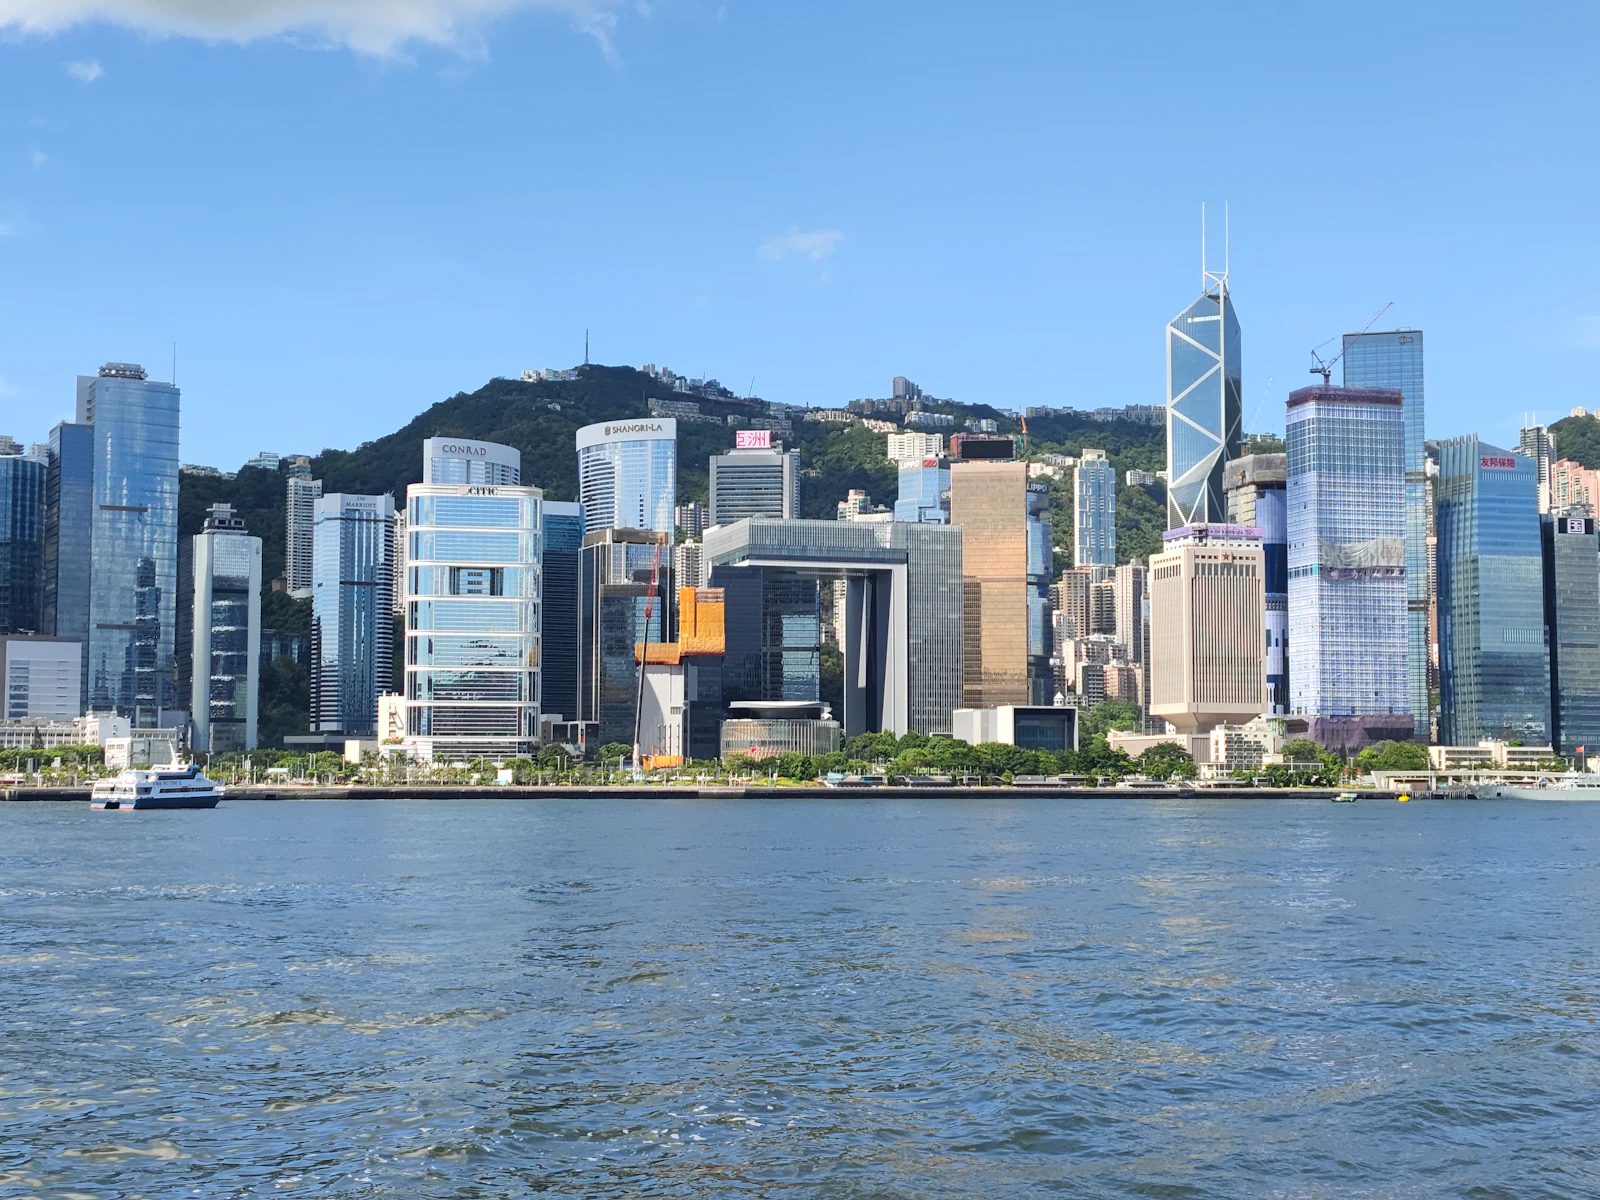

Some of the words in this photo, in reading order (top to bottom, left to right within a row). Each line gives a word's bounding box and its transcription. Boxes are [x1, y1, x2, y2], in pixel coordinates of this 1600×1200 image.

[611, 424, 663, 434] SHANGRI-LA
[442, 444, 487, 456] CONRAD
[900, 459, 920, 469] LIPPO
[1480, 457, 1516, 468] 友邦保險
[469, 486, 498, 496] CITIC
[1026, 483, 1048, 492] LIPPO
